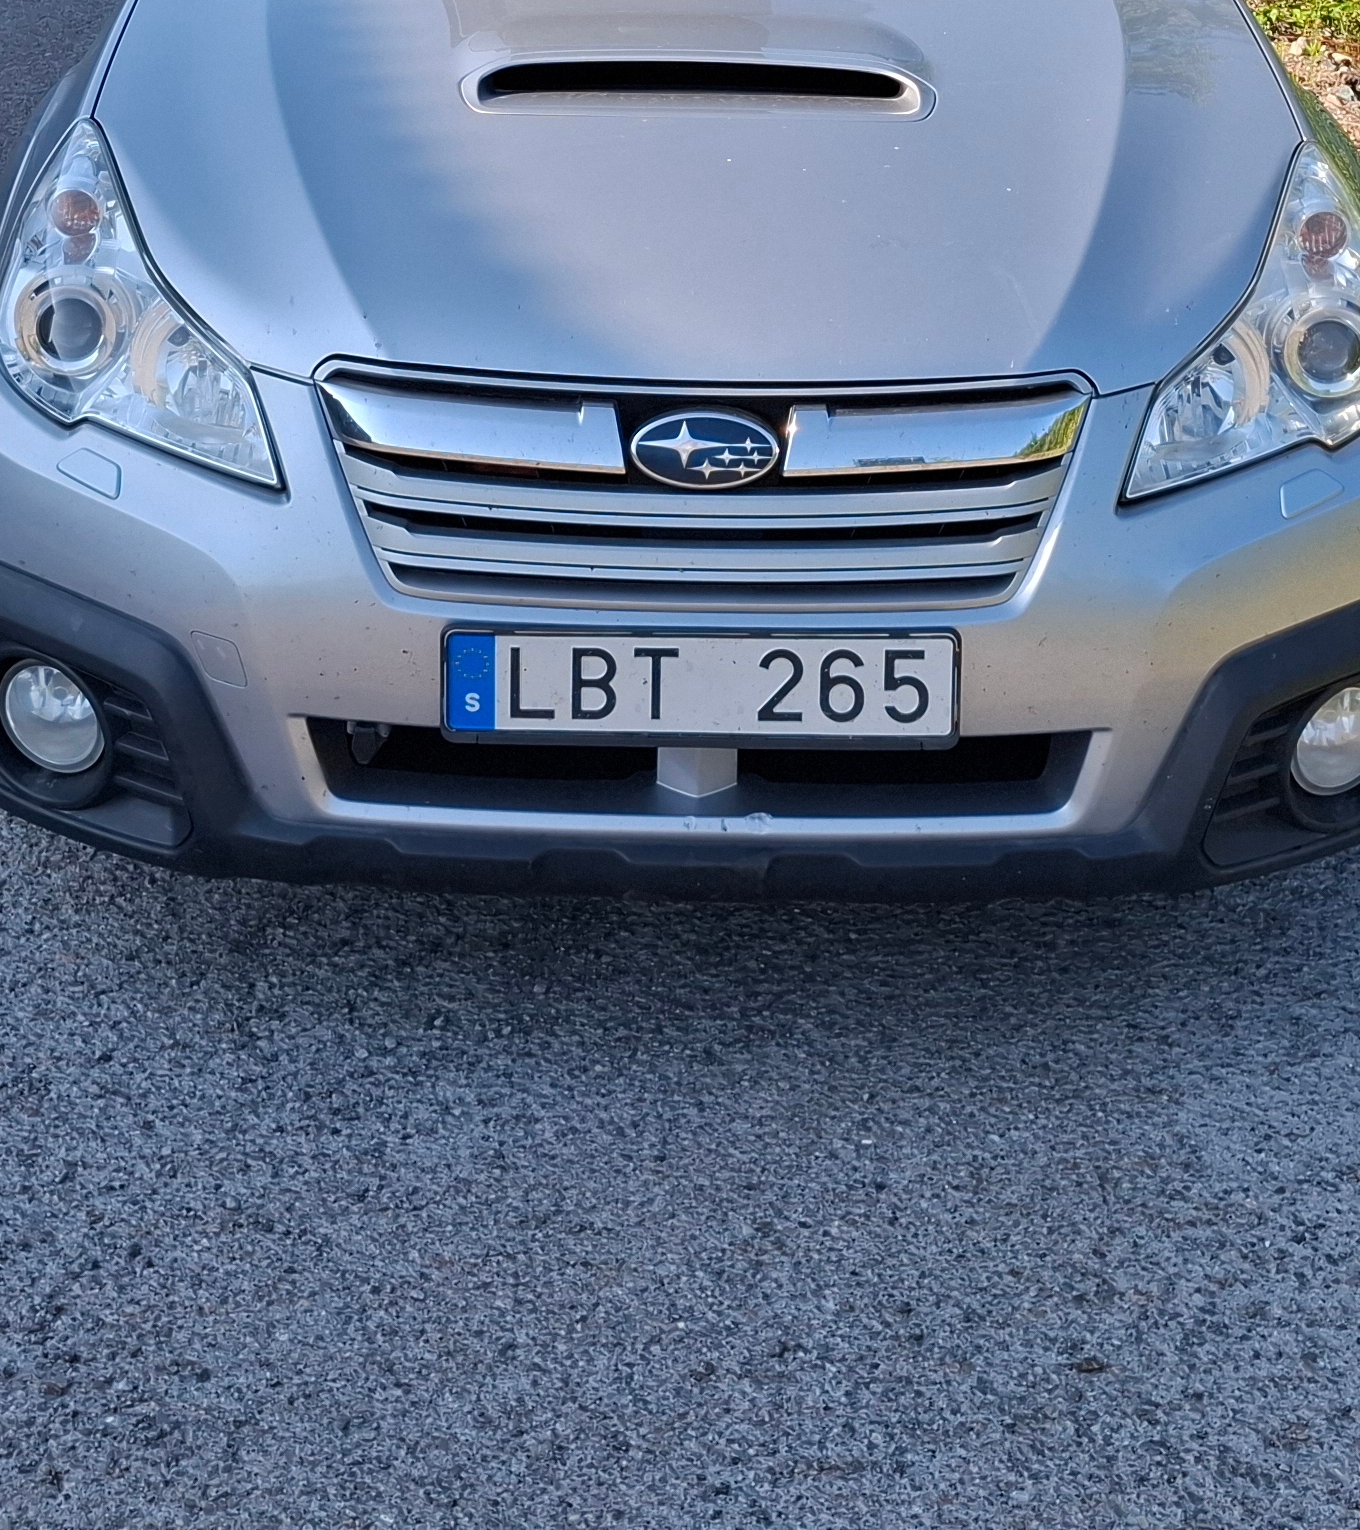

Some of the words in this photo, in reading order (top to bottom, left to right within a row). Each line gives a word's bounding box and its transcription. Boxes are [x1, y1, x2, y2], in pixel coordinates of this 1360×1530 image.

[465, 692, 481, 713] S
[509, 646, 680, 720] LBT
[756, 648, 930, 724] 265
